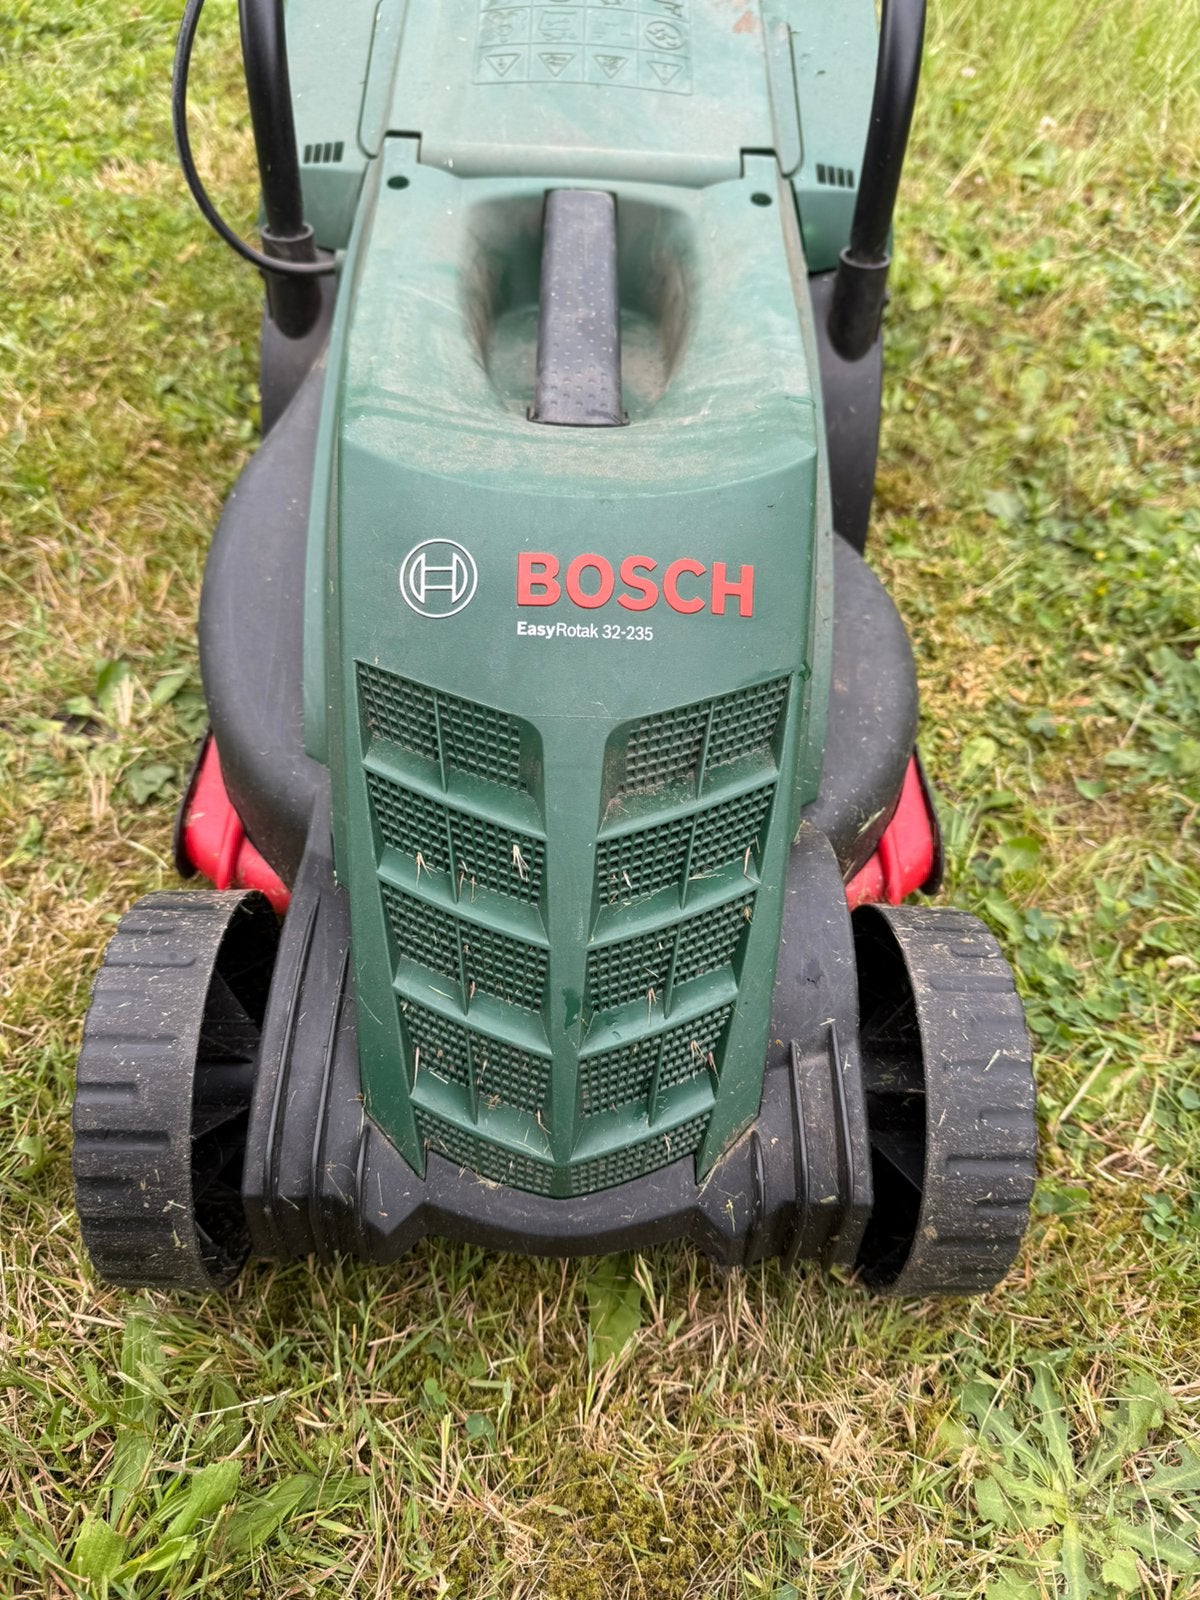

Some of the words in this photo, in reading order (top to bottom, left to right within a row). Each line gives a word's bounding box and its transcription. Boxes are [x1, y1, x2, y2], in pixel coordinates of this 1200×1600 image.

[517, 552, 754, 617] BOSCH
[517, 621, 599, 640] EasyRotak
[602, 624, 654, 641] 32-235
